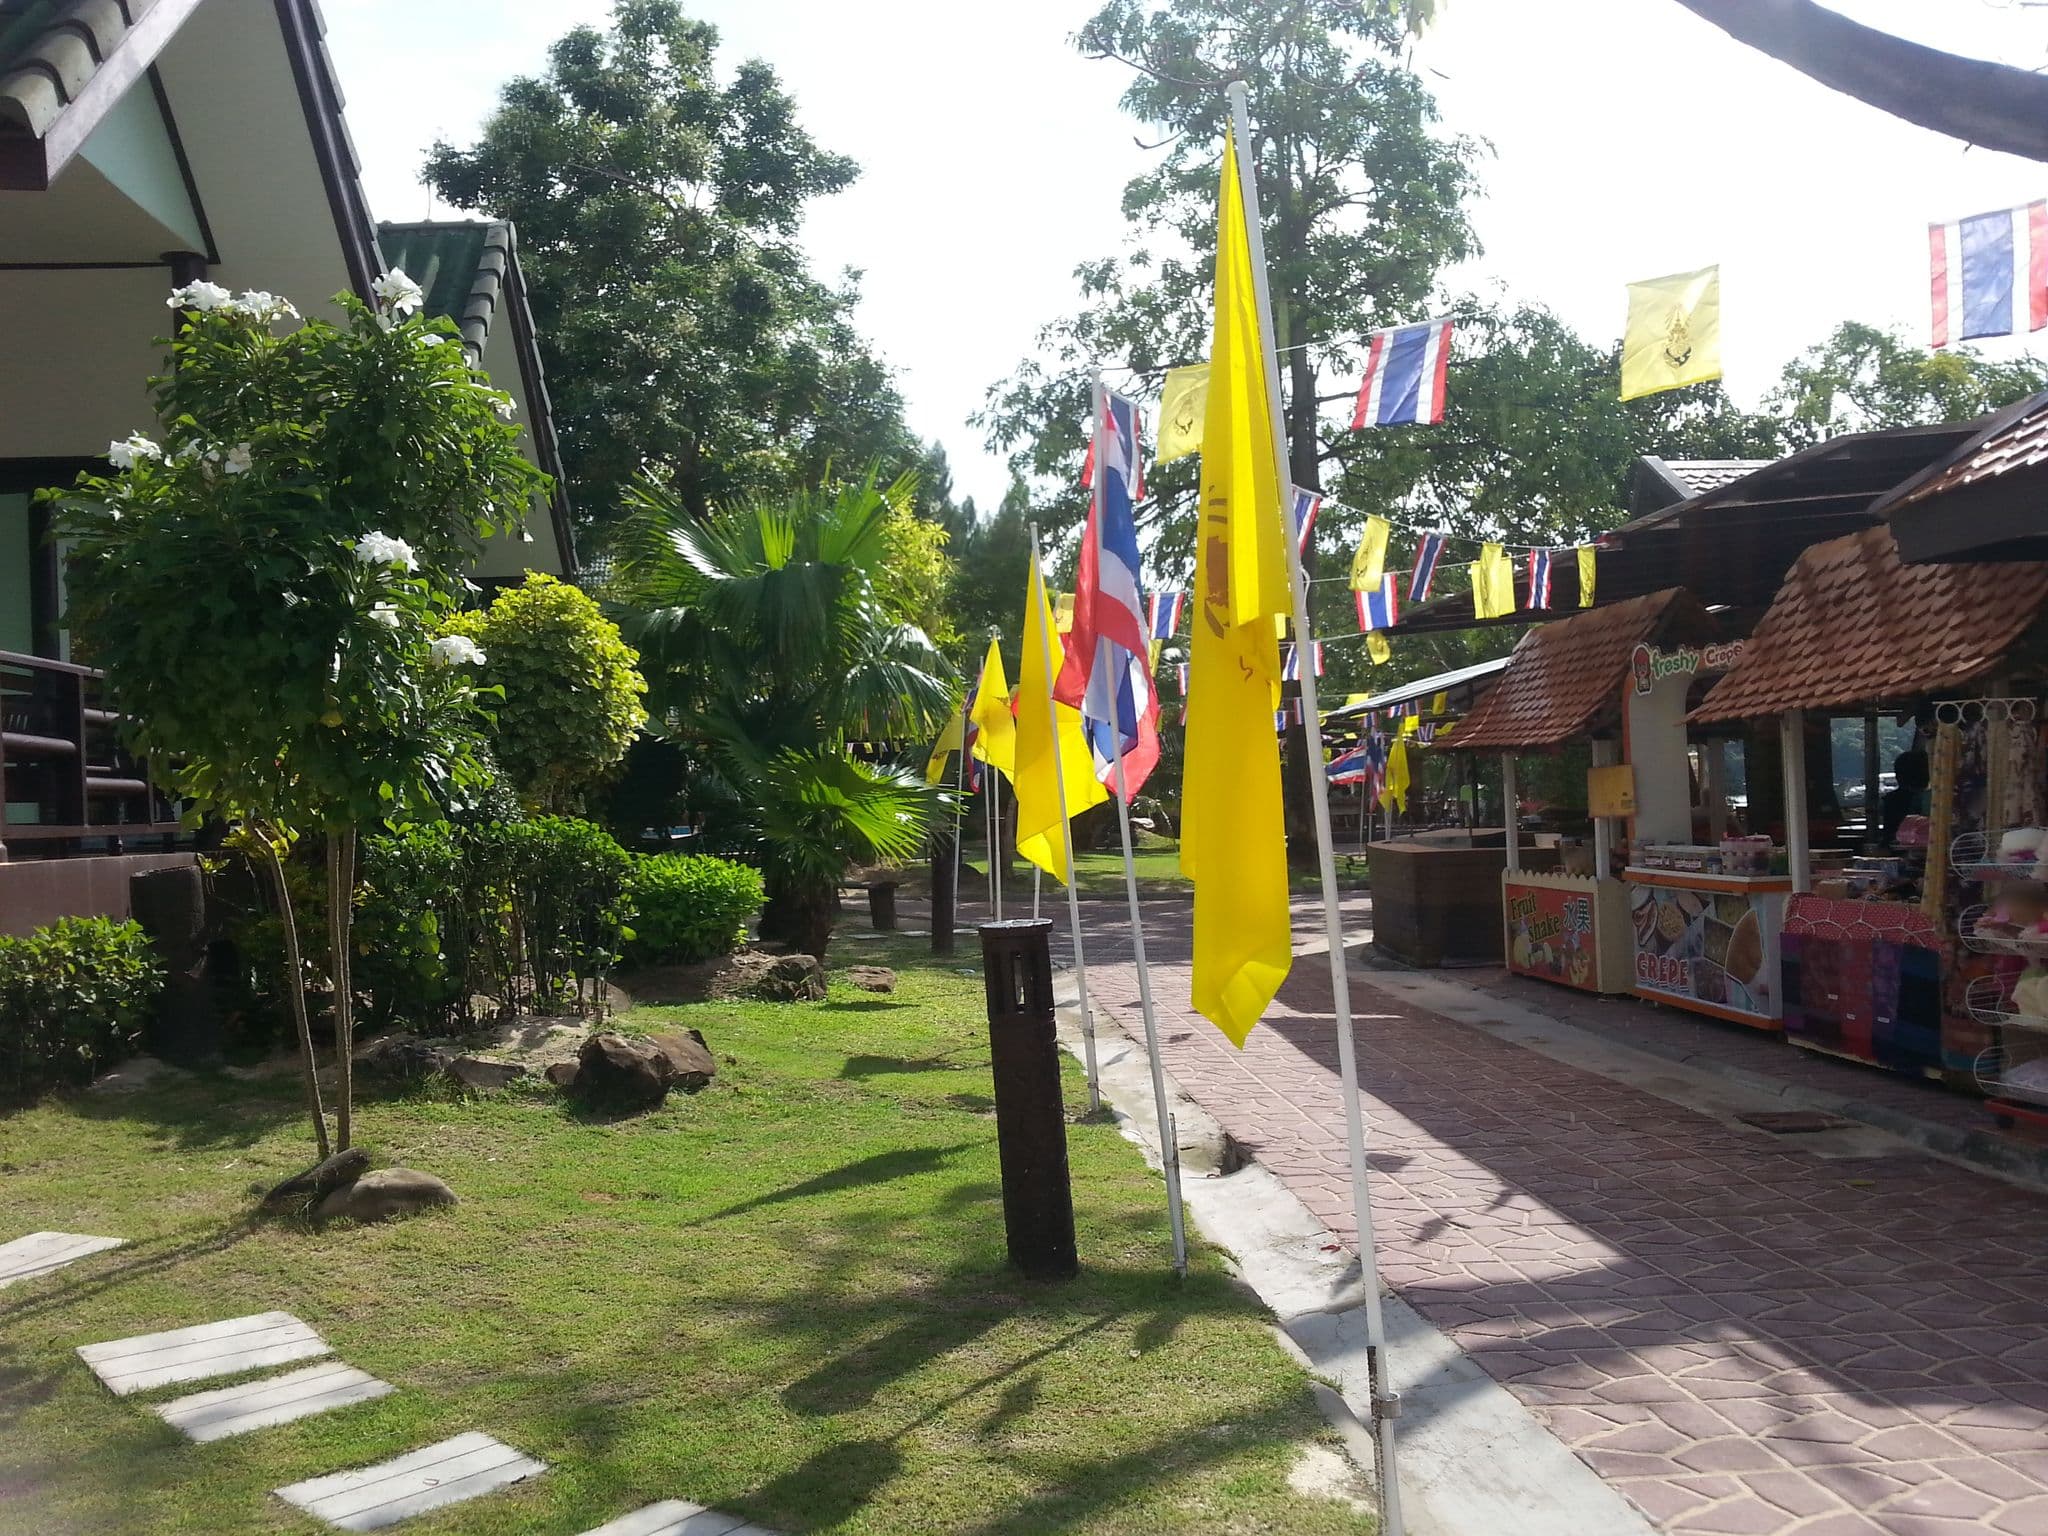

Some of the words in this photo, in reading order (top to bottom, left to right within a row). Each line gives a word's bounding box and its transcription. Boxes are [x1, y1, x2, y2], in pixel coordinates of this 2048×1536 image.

[1652, 648, 1699, 679] freshy
[1510, 891, 1537, 920] Fruit
[1563, 897, 1592, 933] 水果
[1636, 951, 1689, 988] CREPE
